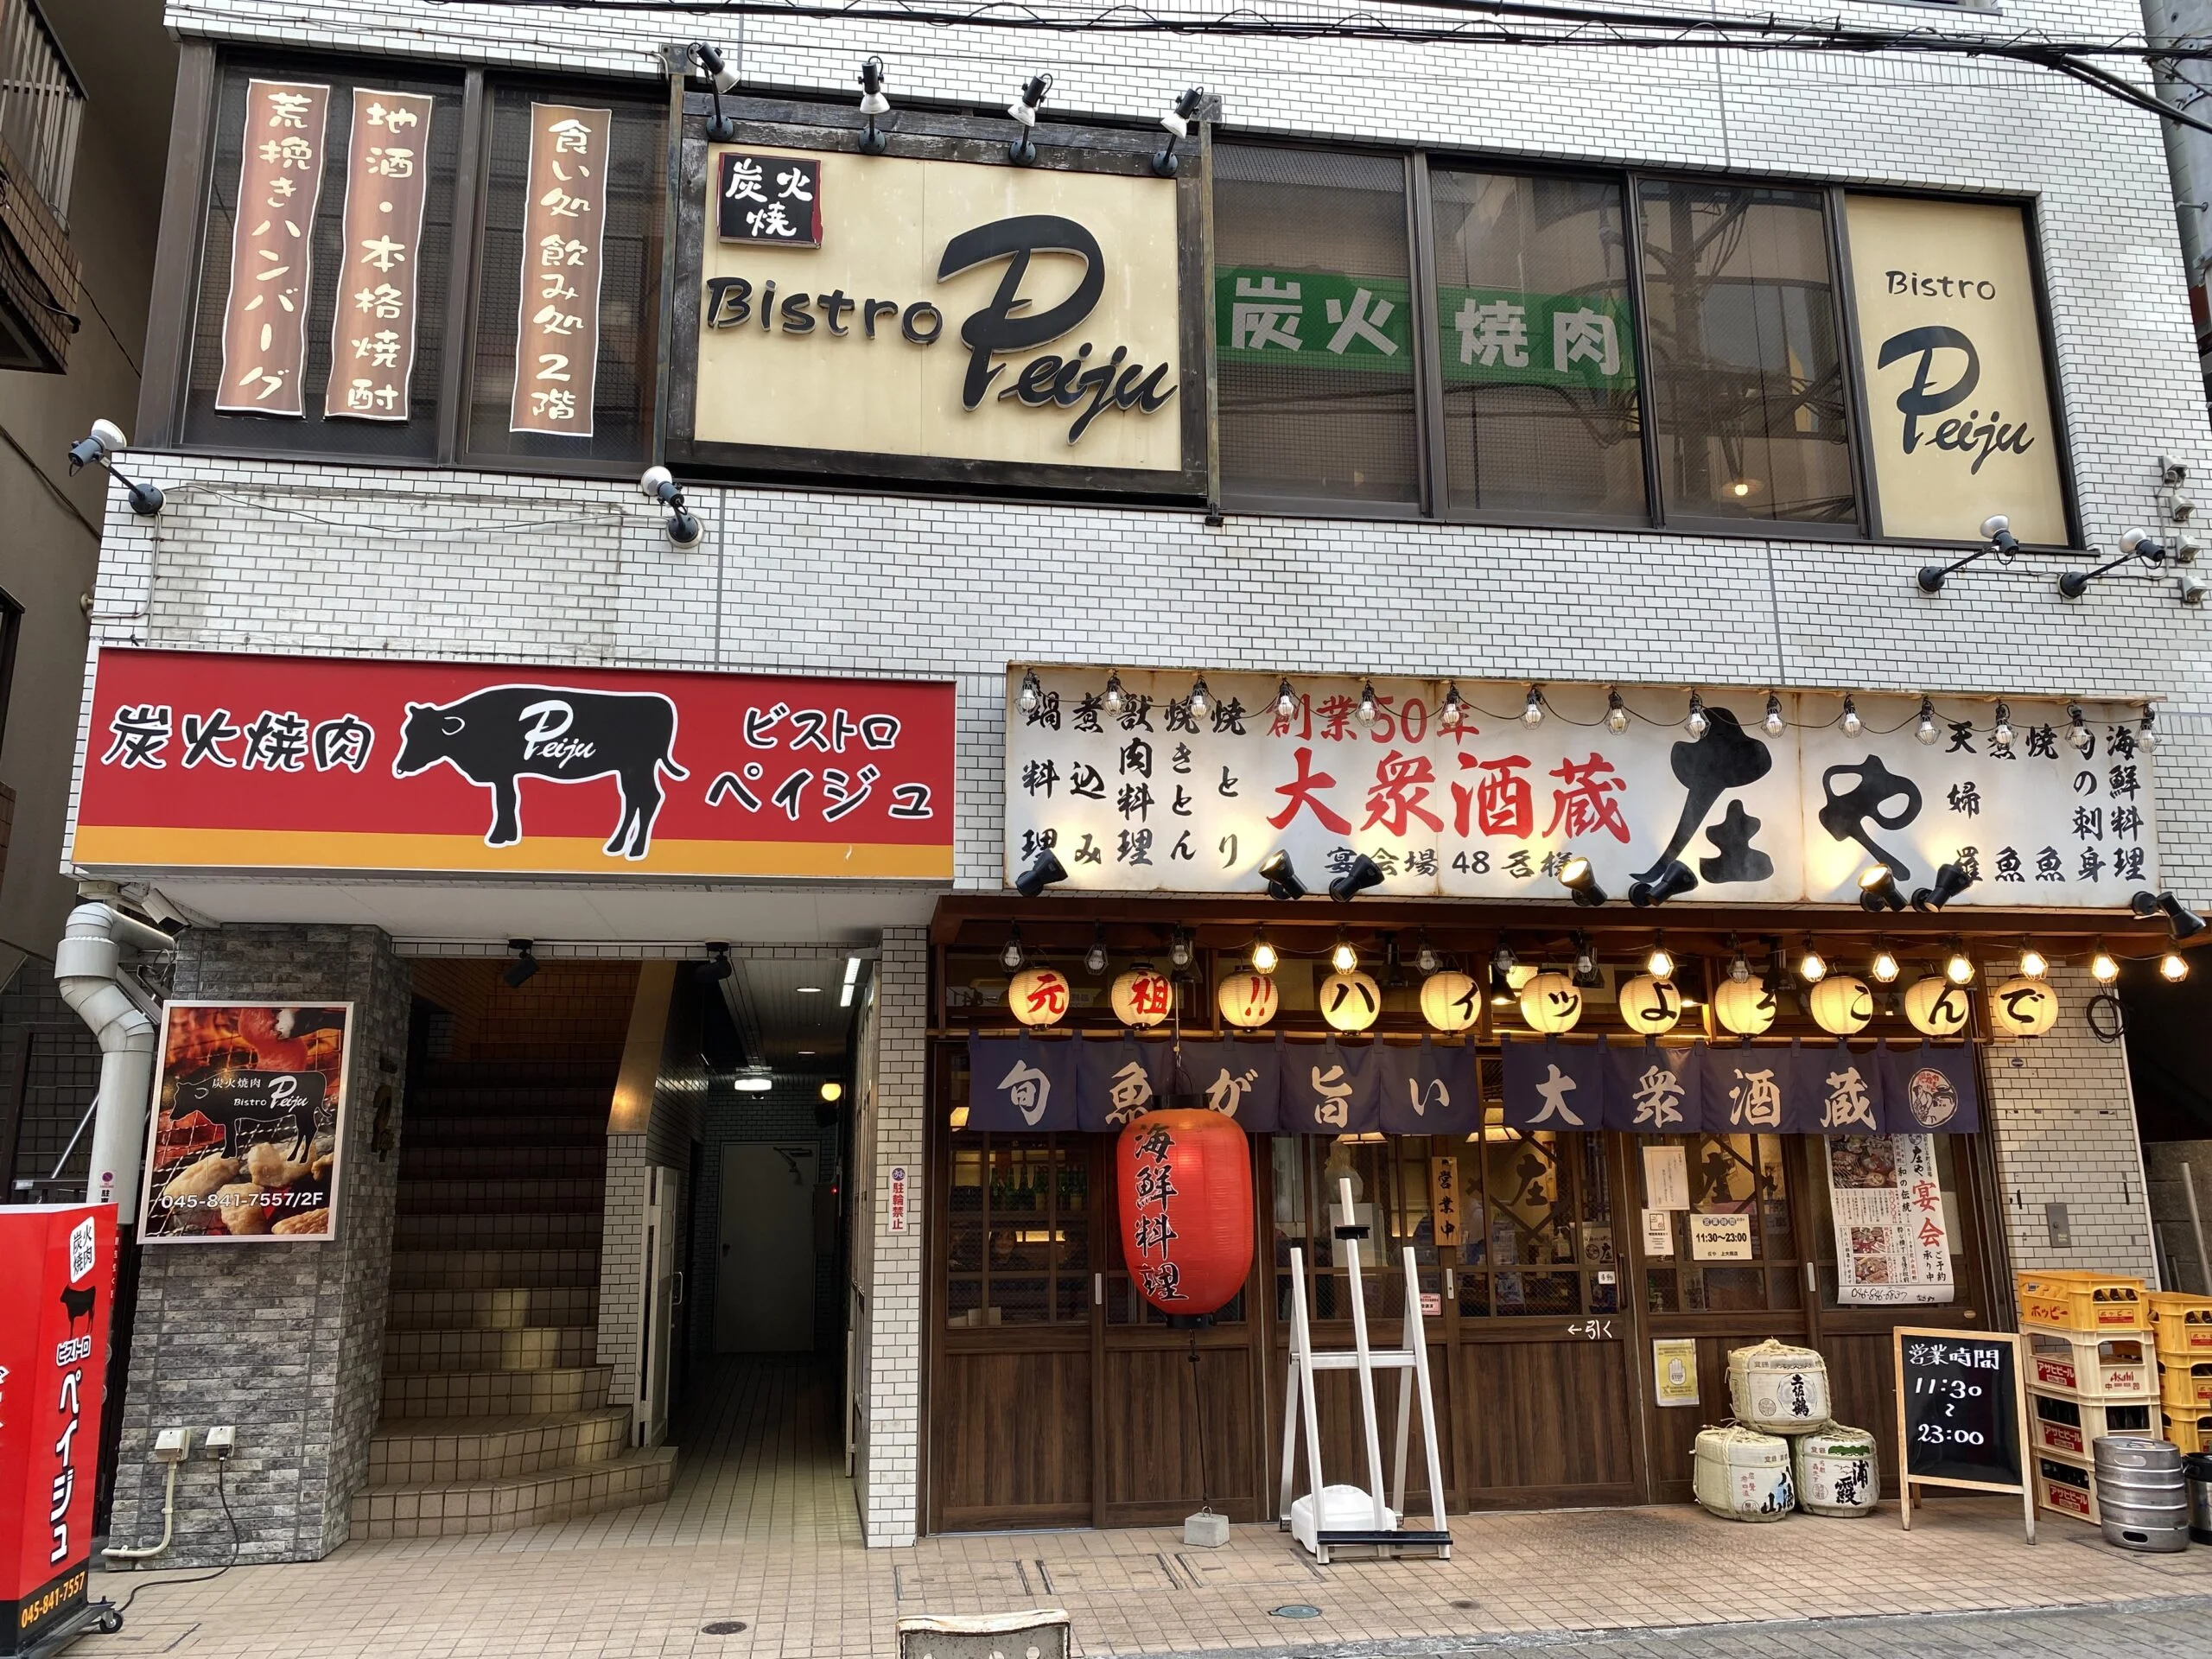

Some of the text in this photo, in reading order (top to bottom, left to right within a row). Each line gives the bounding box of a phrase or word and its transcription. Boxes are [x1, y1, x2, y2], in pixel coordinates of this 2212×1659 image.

[725, 157, 813, 202] 炭火
[238, 92, 313, 401] 荒挽きハンバーグ
[346, 101, 418, 412] 地酒・本格焼酎
[1885, 270, 1998, 302] Bistro
[706, 213, 1179, 447] Bistro Peiju
[1230, 275, 1623, 378] 炭火焼肉
[1877, 324, 2037, 477] Peiju
[100, 703, 375, 775] 炭火焼肉
[518, 699, 598, 763] Peiju
[743, 703, 902, 753] ビストロ
[1265, 692, 1480, 747] 創業50年
[705, 760, 935, 823] ペイジュ
[1021, 689, 1060, 865] 鍋料理
[1070, 692, 1107, 865] 煮込み
[1116, 694, 1155, 867] 獣肉料理
[1164, 695, 1201, 861] 焼きとん
[1211, 696, 1247, 869] 焼とり
[1266, 745, 1631, 843] 大衆酒蔵
[1629, 704, 1923, 884] 庄や
[1945, 721, 1984, 882] 天婦羅
[2025, 722, 2066, 883] 焼魚
[2106, 725, 2146, 881] 海鮮料理
[212, 1077, 262, 1090] 炭火焼肉
[233, 1075, 309, 1113] Bistro Peiju
[996, 1058, 1452, 1129] 旬魚が旨い
[1525, 1064, 1878, 1131] 大衆酒蔵
[160, 1192, 324, 1210] 045-841-7557/2F
[892, 1182, 905, 1230] 駐輪禁止
[1134, 1122, 1190, 1302] 海鮮料理
[1438, 1170, 1456, 1241] 営業中
[1897, 1166, 1912, 1212] 和の伝統
[1912, 1179, 1945, 1247] 宴会
[73, 1224, 92, 1254] 炭火
[73, 1247, 92, 1276] 焼肉
[1923, 1249, 1935, 1282] 承り中
[1935, 1250, 1947, 1281] ご予約
[1585, 1319, 1613, 1340] 引く
[2031, 1306, 2069, 1320] ホッピー
[55, 1335, 92, 1367] ビストロ
[1908, 1344, 2000, 1370] 営業時間
[2037, 1362, 2075, 1378] アサヒビール
[2110, 1370, 2134, 1382] Asahi
[1790, 1373, 1809, 1417] 土佐鶴
[1915, 1376, 1983, 1399] 11:30
[1917, 1423, 1985, 1446] 23:00
[2044, 1425, 2082, 1443] アサヒビール
[50, 1369, 82, 1565] ペイジュ
[1834, 1459, 1870, 1506] 浦霞
[2050, 1484, 2088, 1504] アサヒビール
[21, 1571, 86, 1630] 045-841-7557
